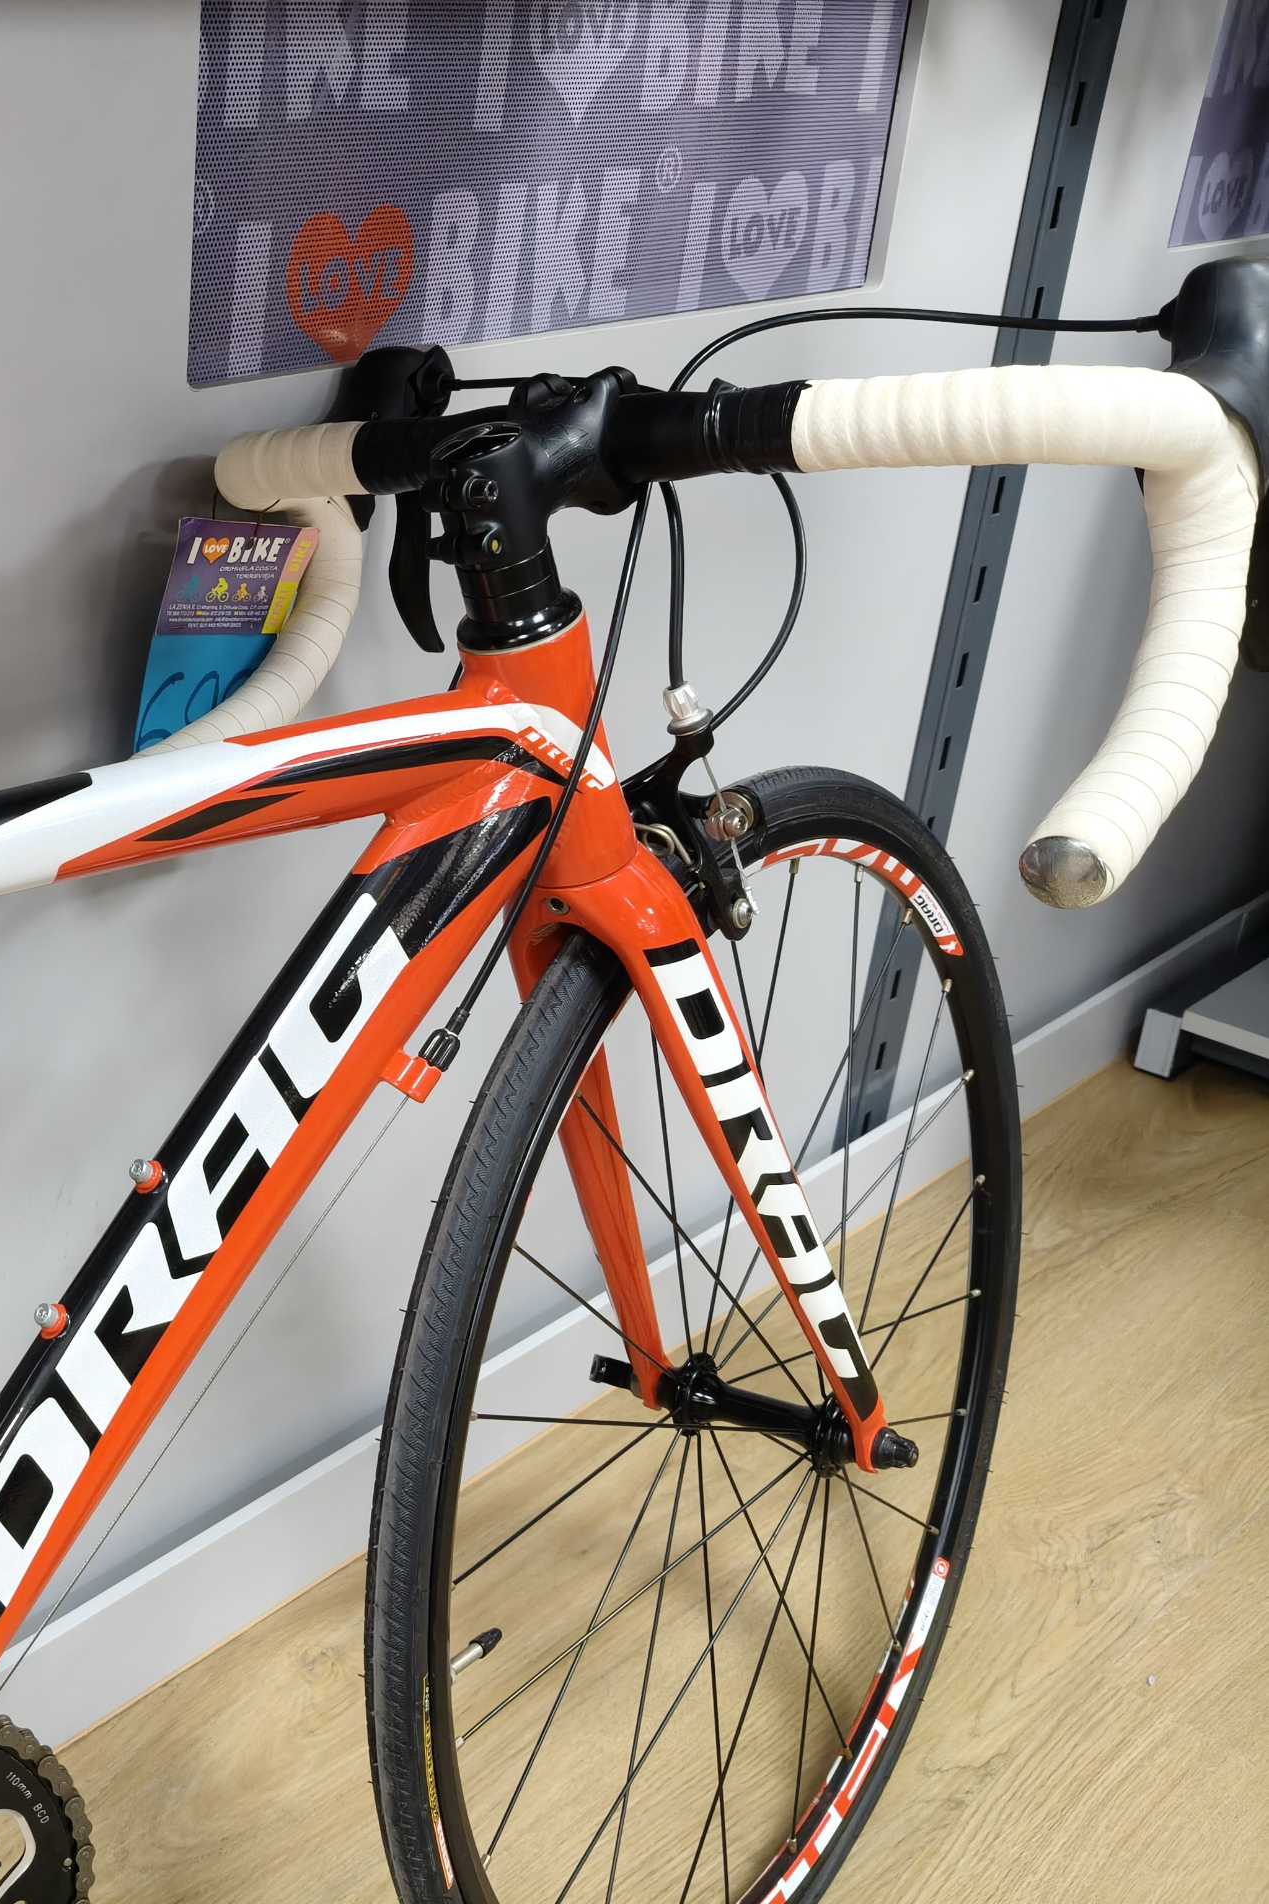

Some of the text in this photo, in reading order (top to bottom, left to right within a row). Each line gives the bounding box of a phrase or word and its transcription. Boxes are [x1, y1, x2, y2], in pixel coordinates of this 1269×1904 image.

[297, 246, 404, 315] LOVE
[728, 206, 803, 264] LOVE
[204, 543, 229, 554] LOVE
[914, 894, 943, 933] DRAG
[6, 1771, 50, 1824] 110mm BCD
